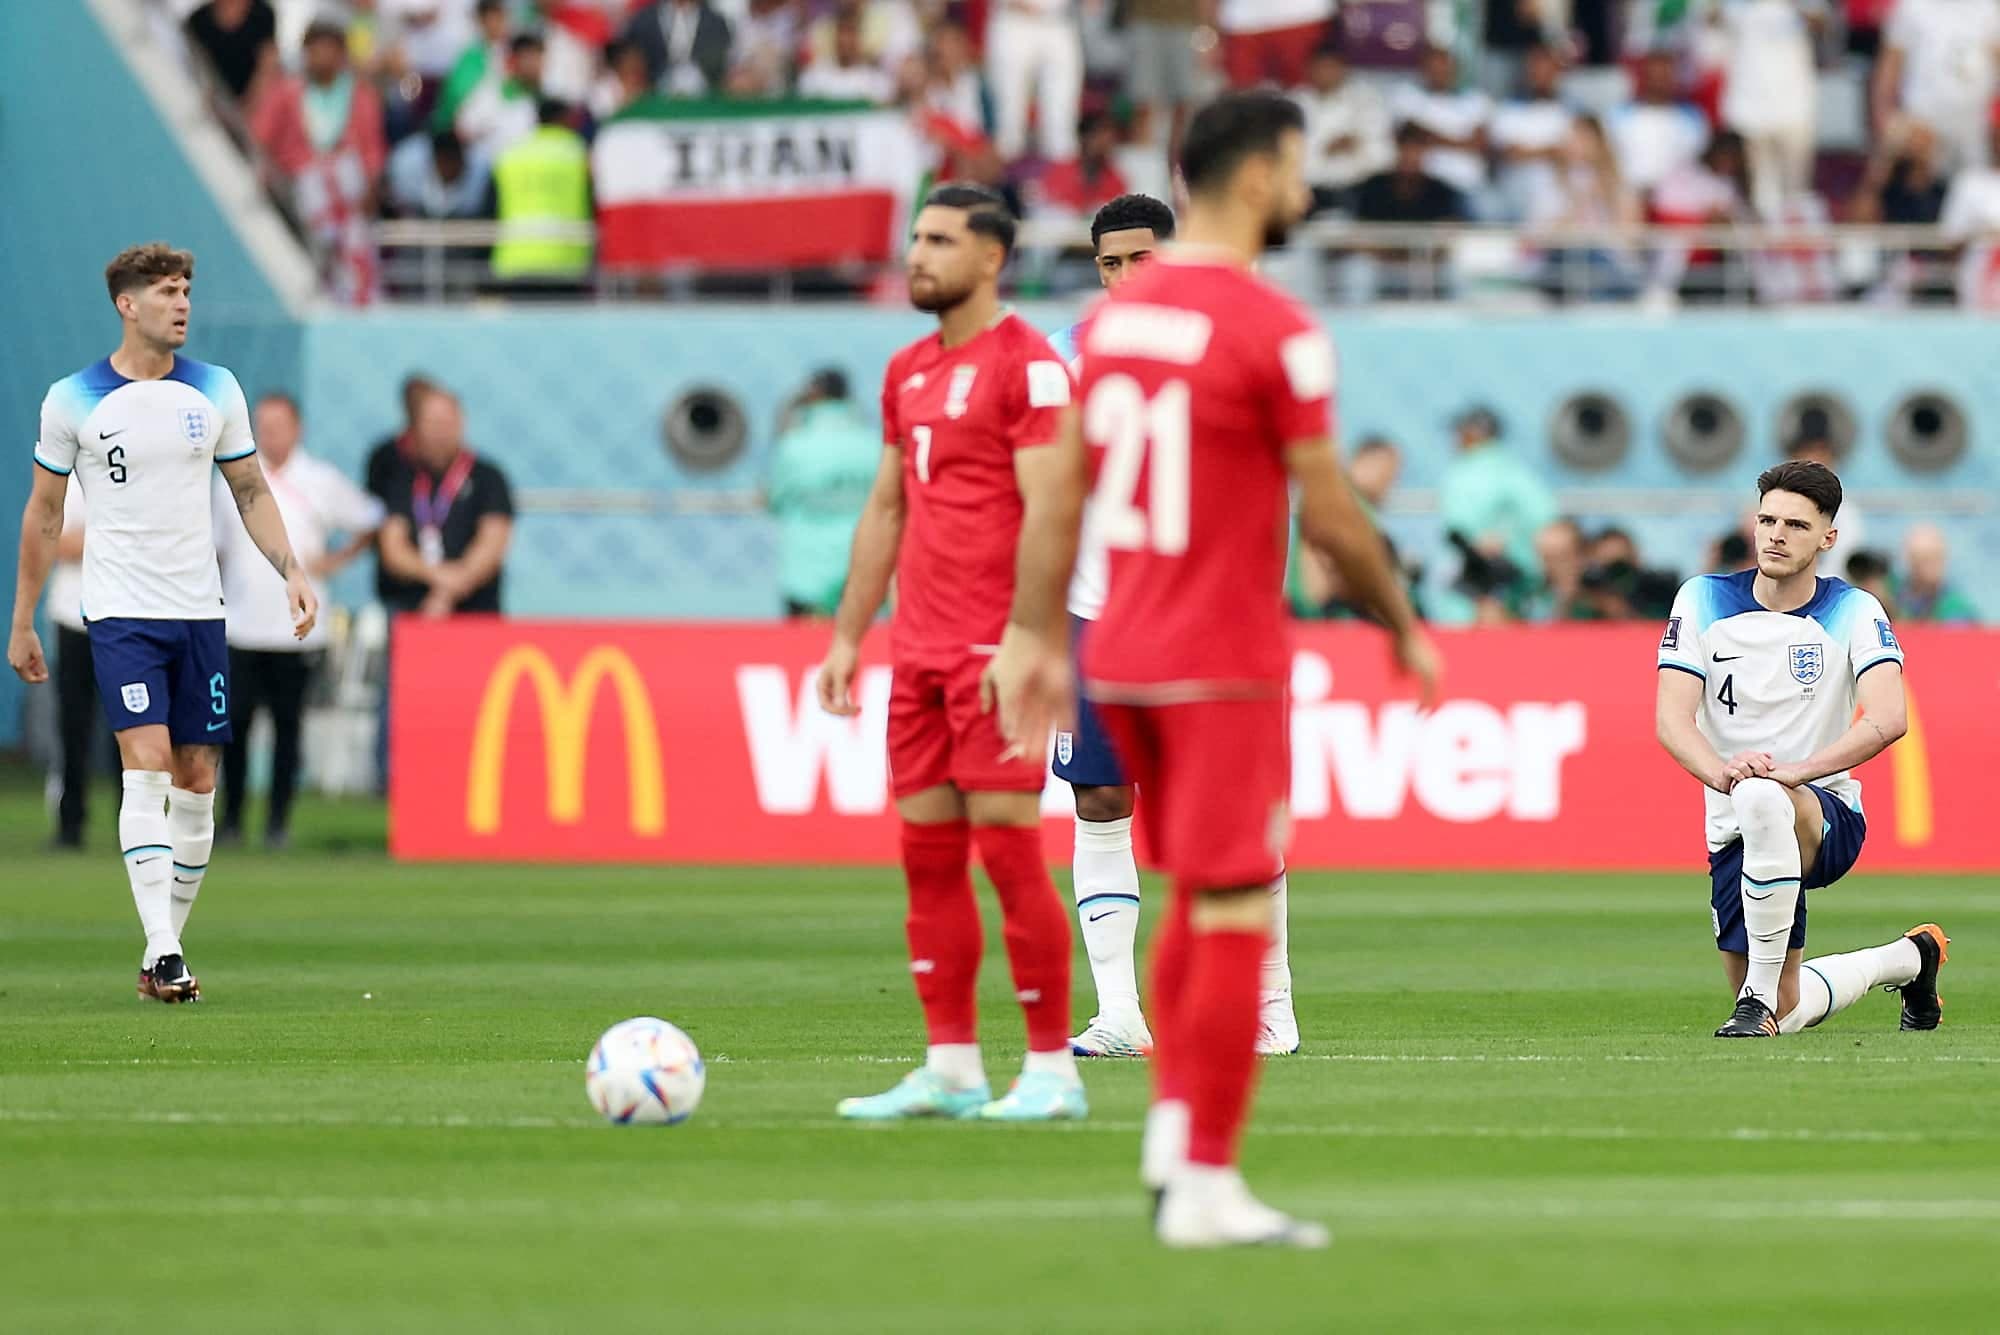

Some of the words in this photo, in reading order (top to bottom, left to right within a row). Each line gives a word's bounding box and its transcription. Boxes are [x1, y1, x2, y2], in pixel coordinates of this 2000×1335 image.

[672, 135, 854, 181] IRAN
[107, 445, 126, 483] 5
[1086, 374, 1191, 556] 21
[210, 672, 226, 714] 5
[1717, 673, 1738, 715] 4
[735, 664, 892, 815] W
